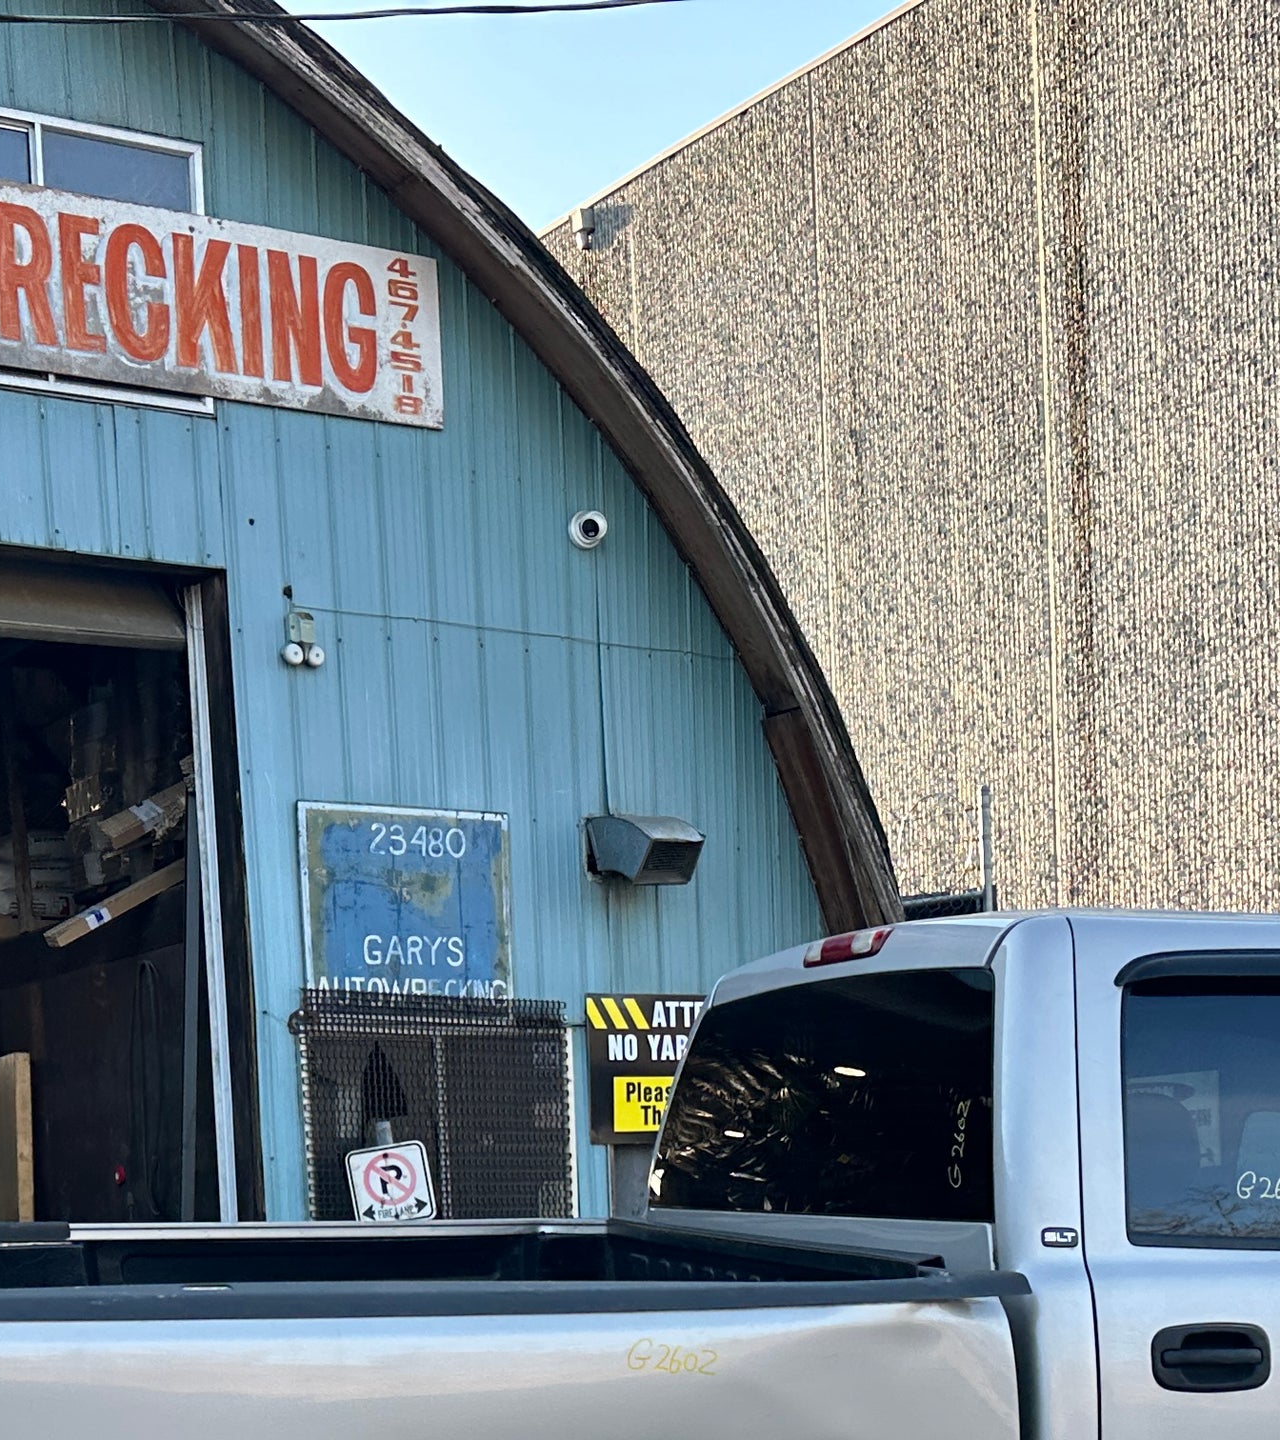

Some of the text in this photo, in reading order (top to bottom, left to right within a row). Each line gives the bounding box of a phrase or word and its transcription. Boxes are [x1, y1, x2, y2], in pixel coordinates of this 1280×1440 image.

[369, 822, 467, 859] 23480
[363, 934, 465, 968] GARY'S
[608, 1034, 638, 1061] NO
[947, 1098, 971, 1189] G2602
[1044, 1231, 1076, 1243] SLT
[626, 1337, 719, 1377] G2602
